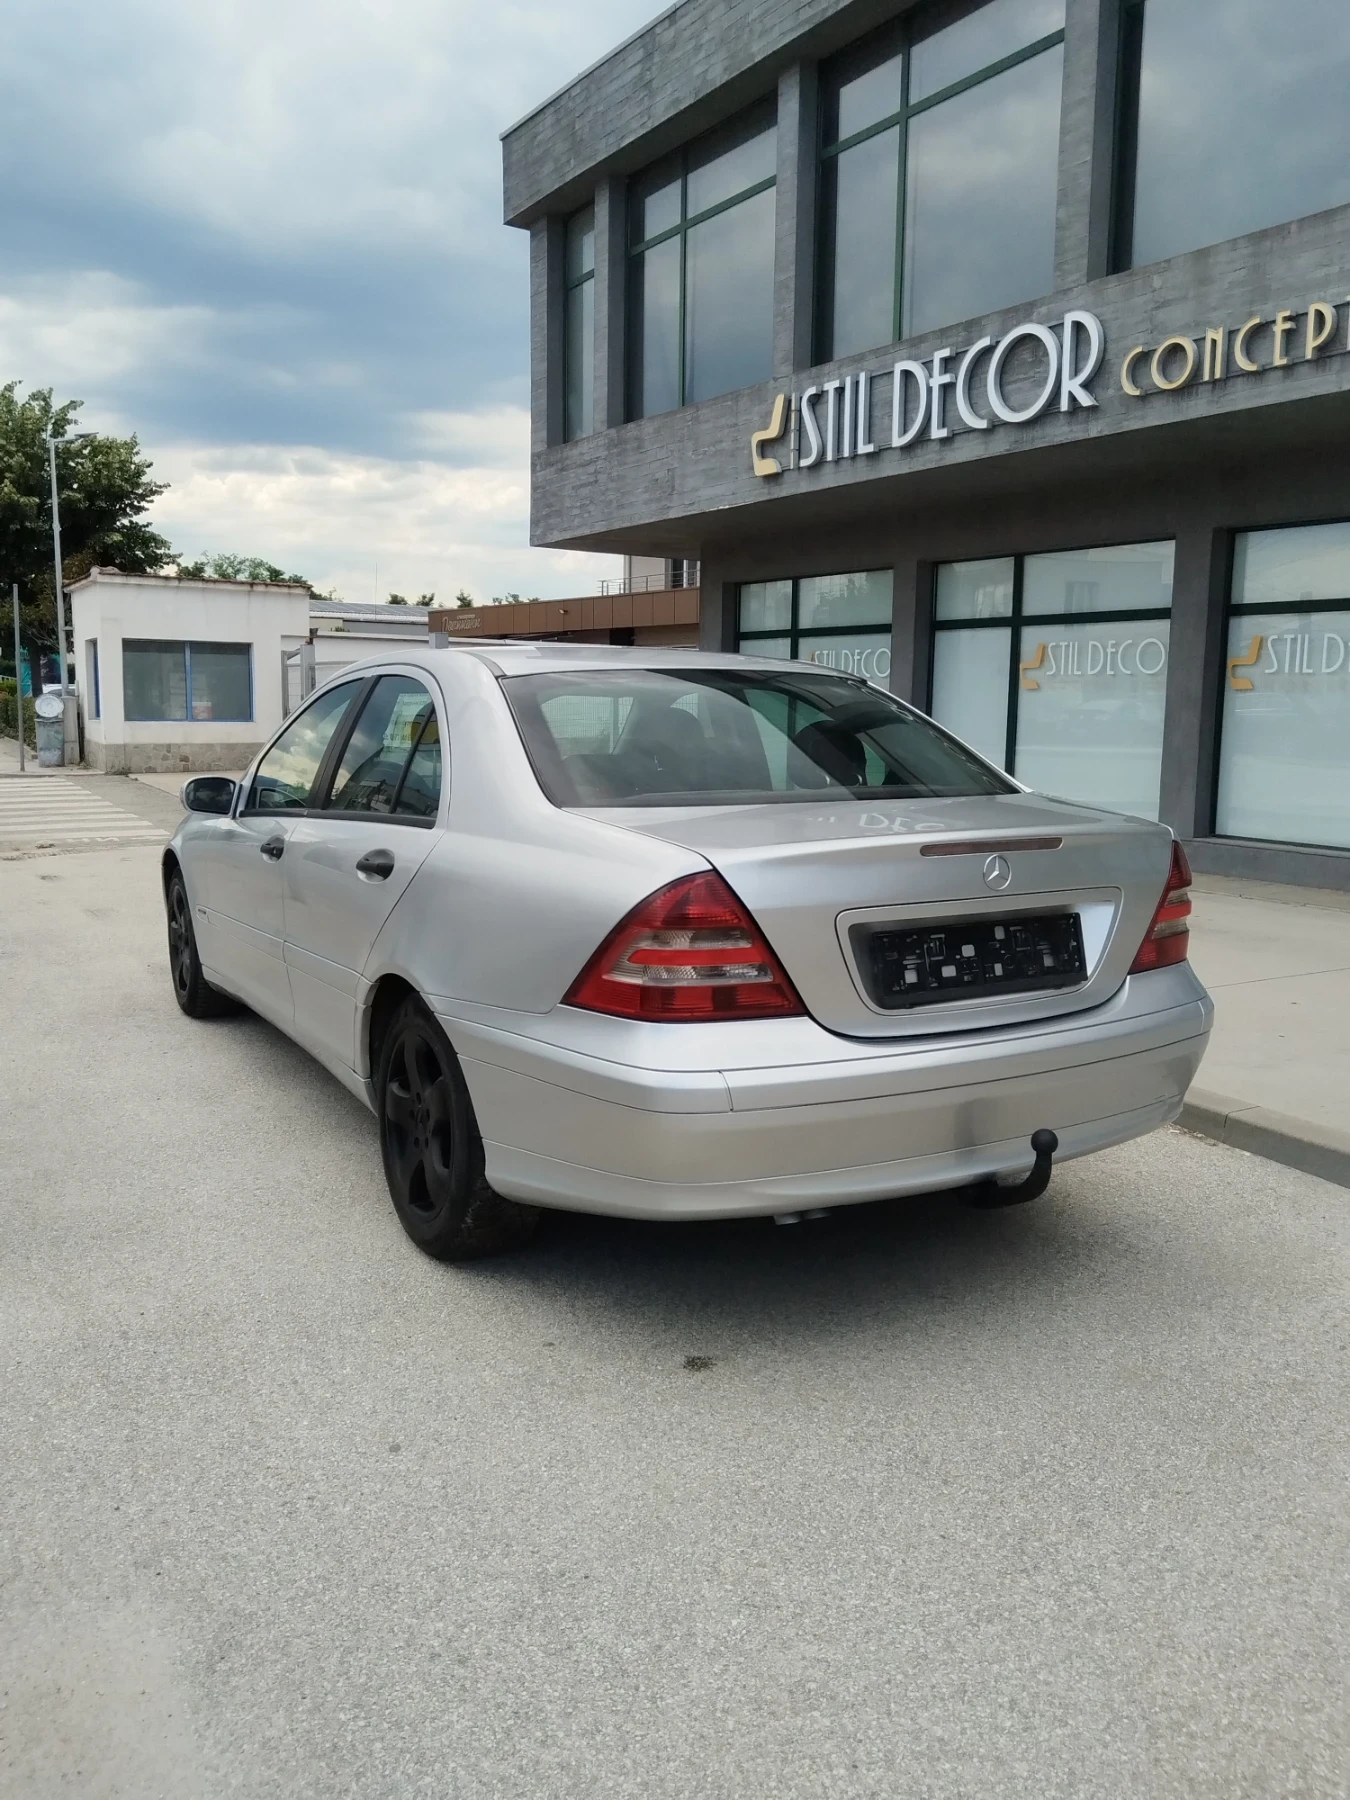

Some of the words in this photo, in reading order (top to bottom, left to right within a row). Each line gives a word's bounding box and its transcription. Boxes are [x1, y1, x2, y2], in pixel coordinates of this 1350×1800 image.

[1120, 294, 1350, 396] CONCEP
[799, 371, 877, 468] STIL
[891, 310, 1105, 449] DECOR
[1046, 641, 1082, 676] STIL
[1264, 633, 1314, 674] STIL
